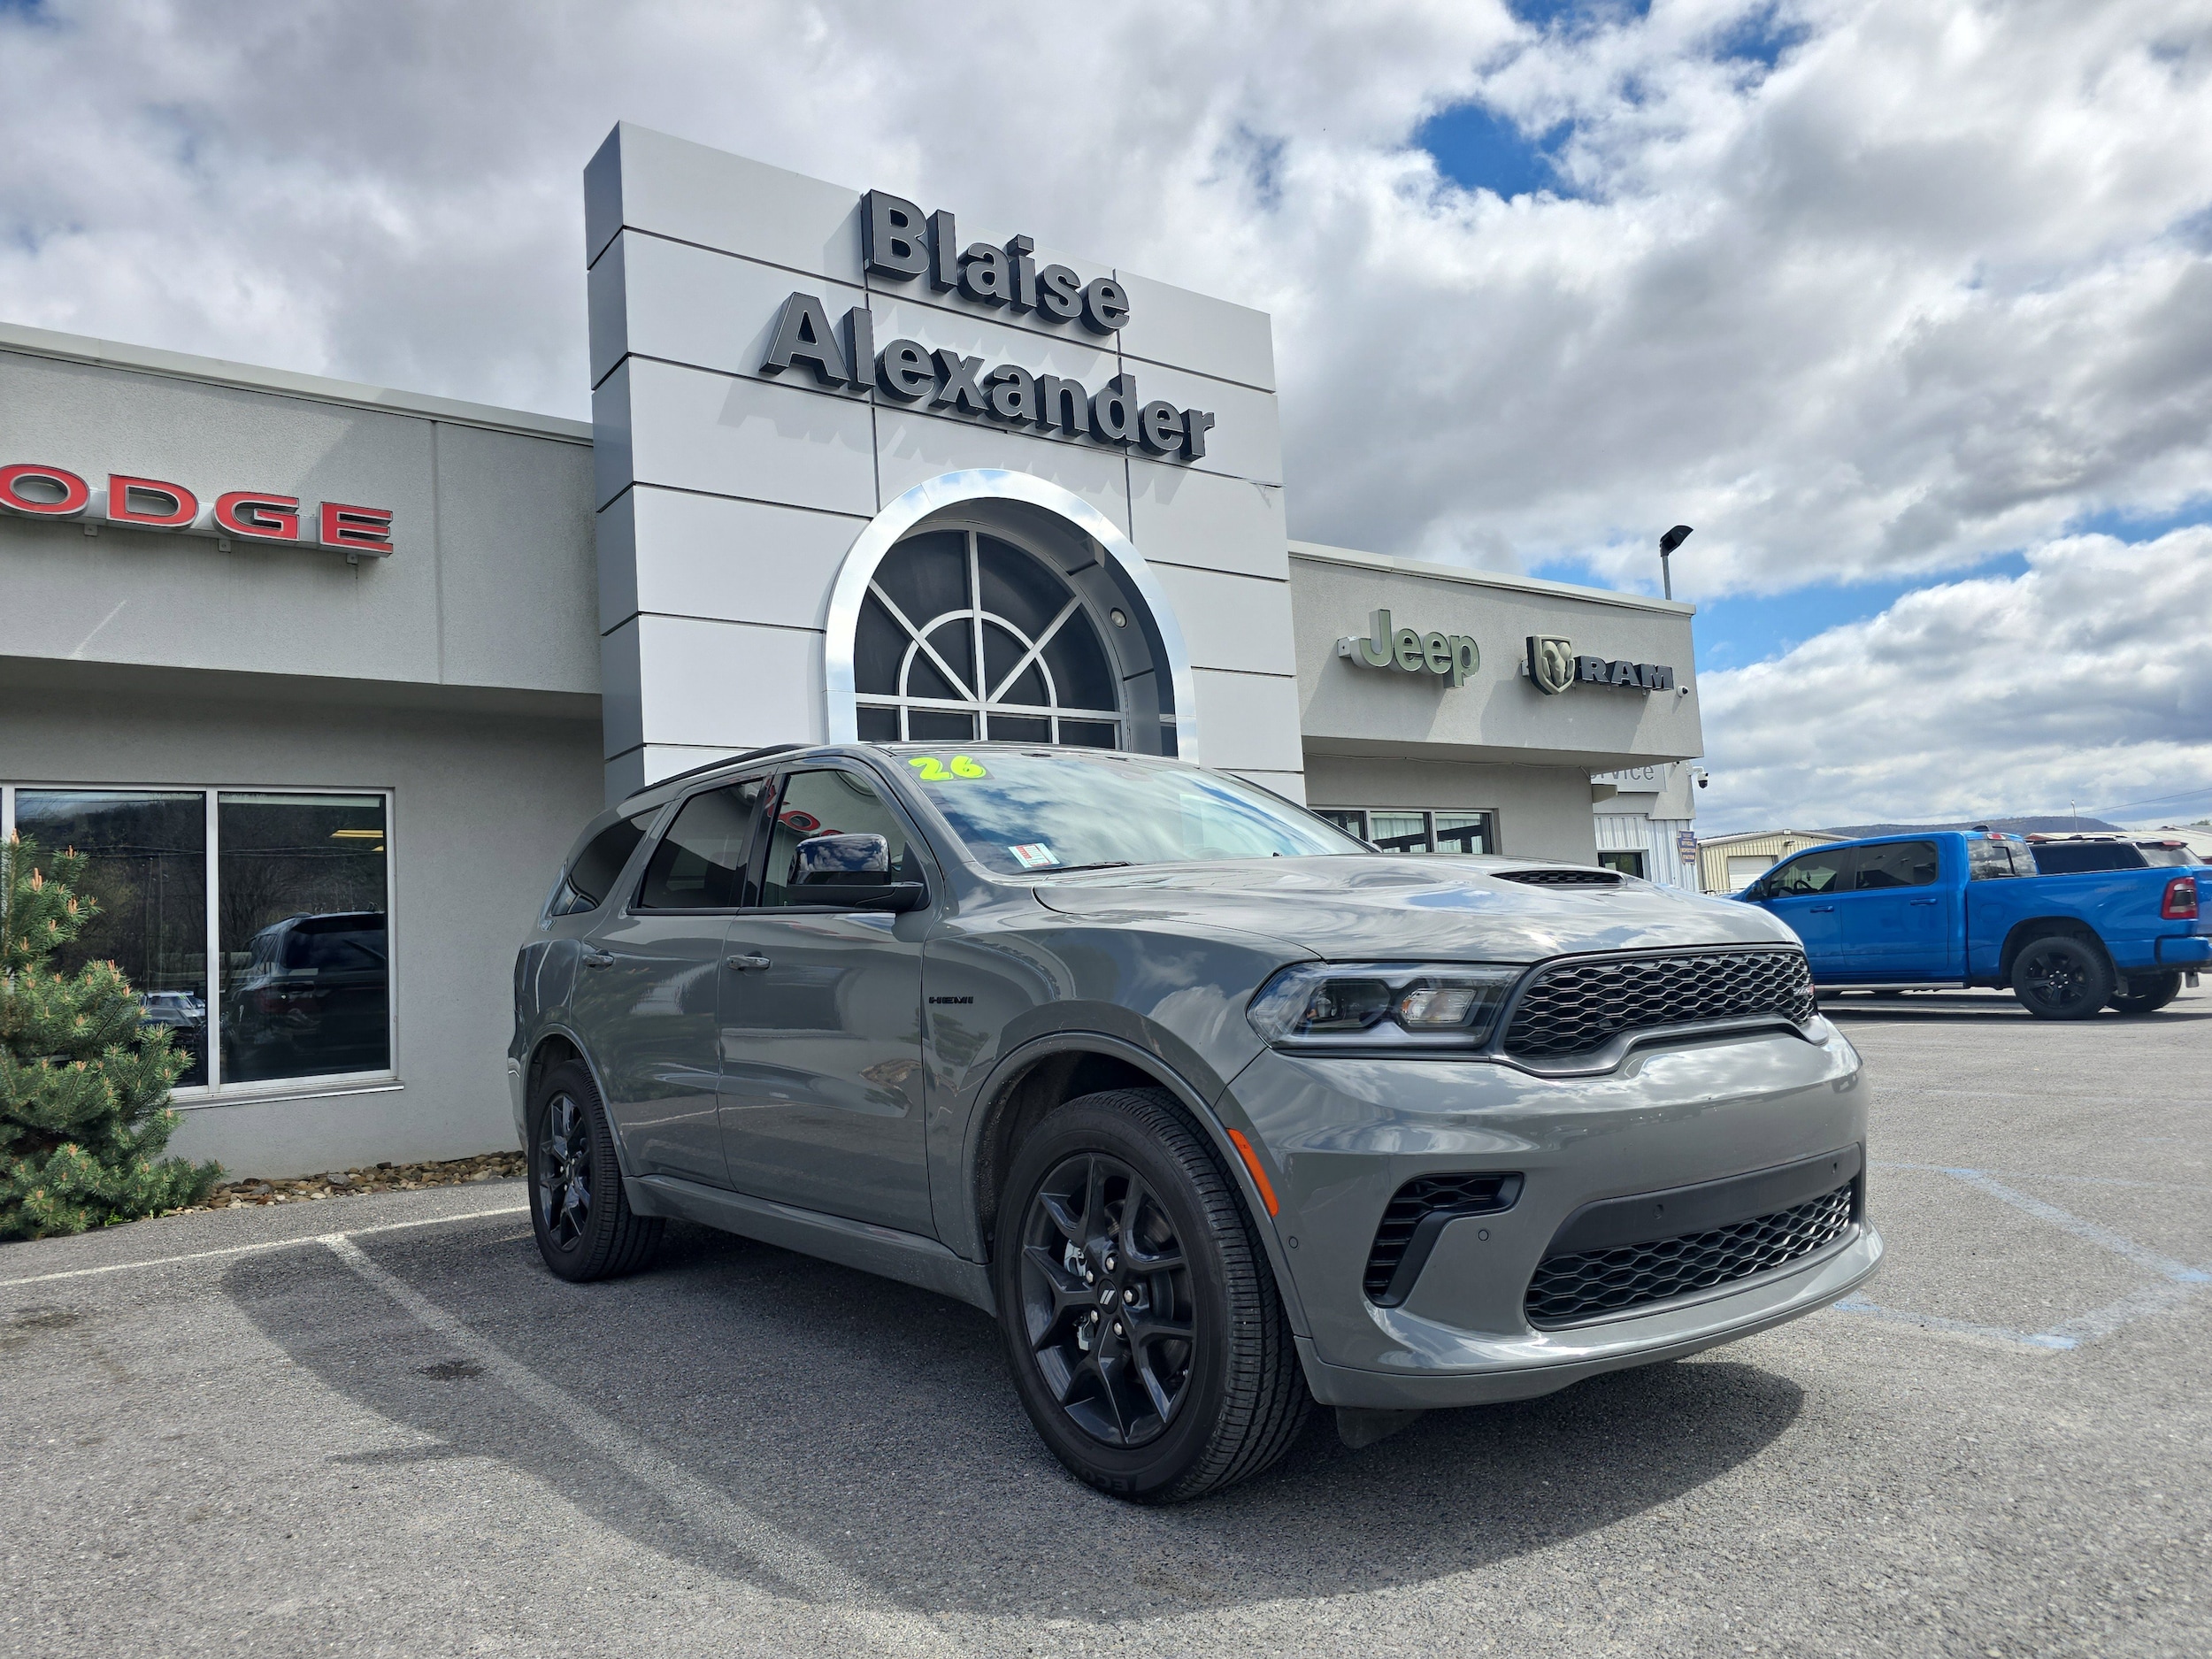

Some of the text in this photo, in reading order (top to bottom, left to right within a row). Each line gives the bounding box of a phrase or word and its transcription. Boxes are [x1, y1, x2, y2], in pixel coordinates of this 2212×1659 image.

[862, 189, 1130, 335] Blaise
[759, 292, 1215, 462] Alexander
[1350, 609, 1480, 687] Jeep
[1575, 655, 1674, 691] RAM
[908, 756, 987, 781] 26
